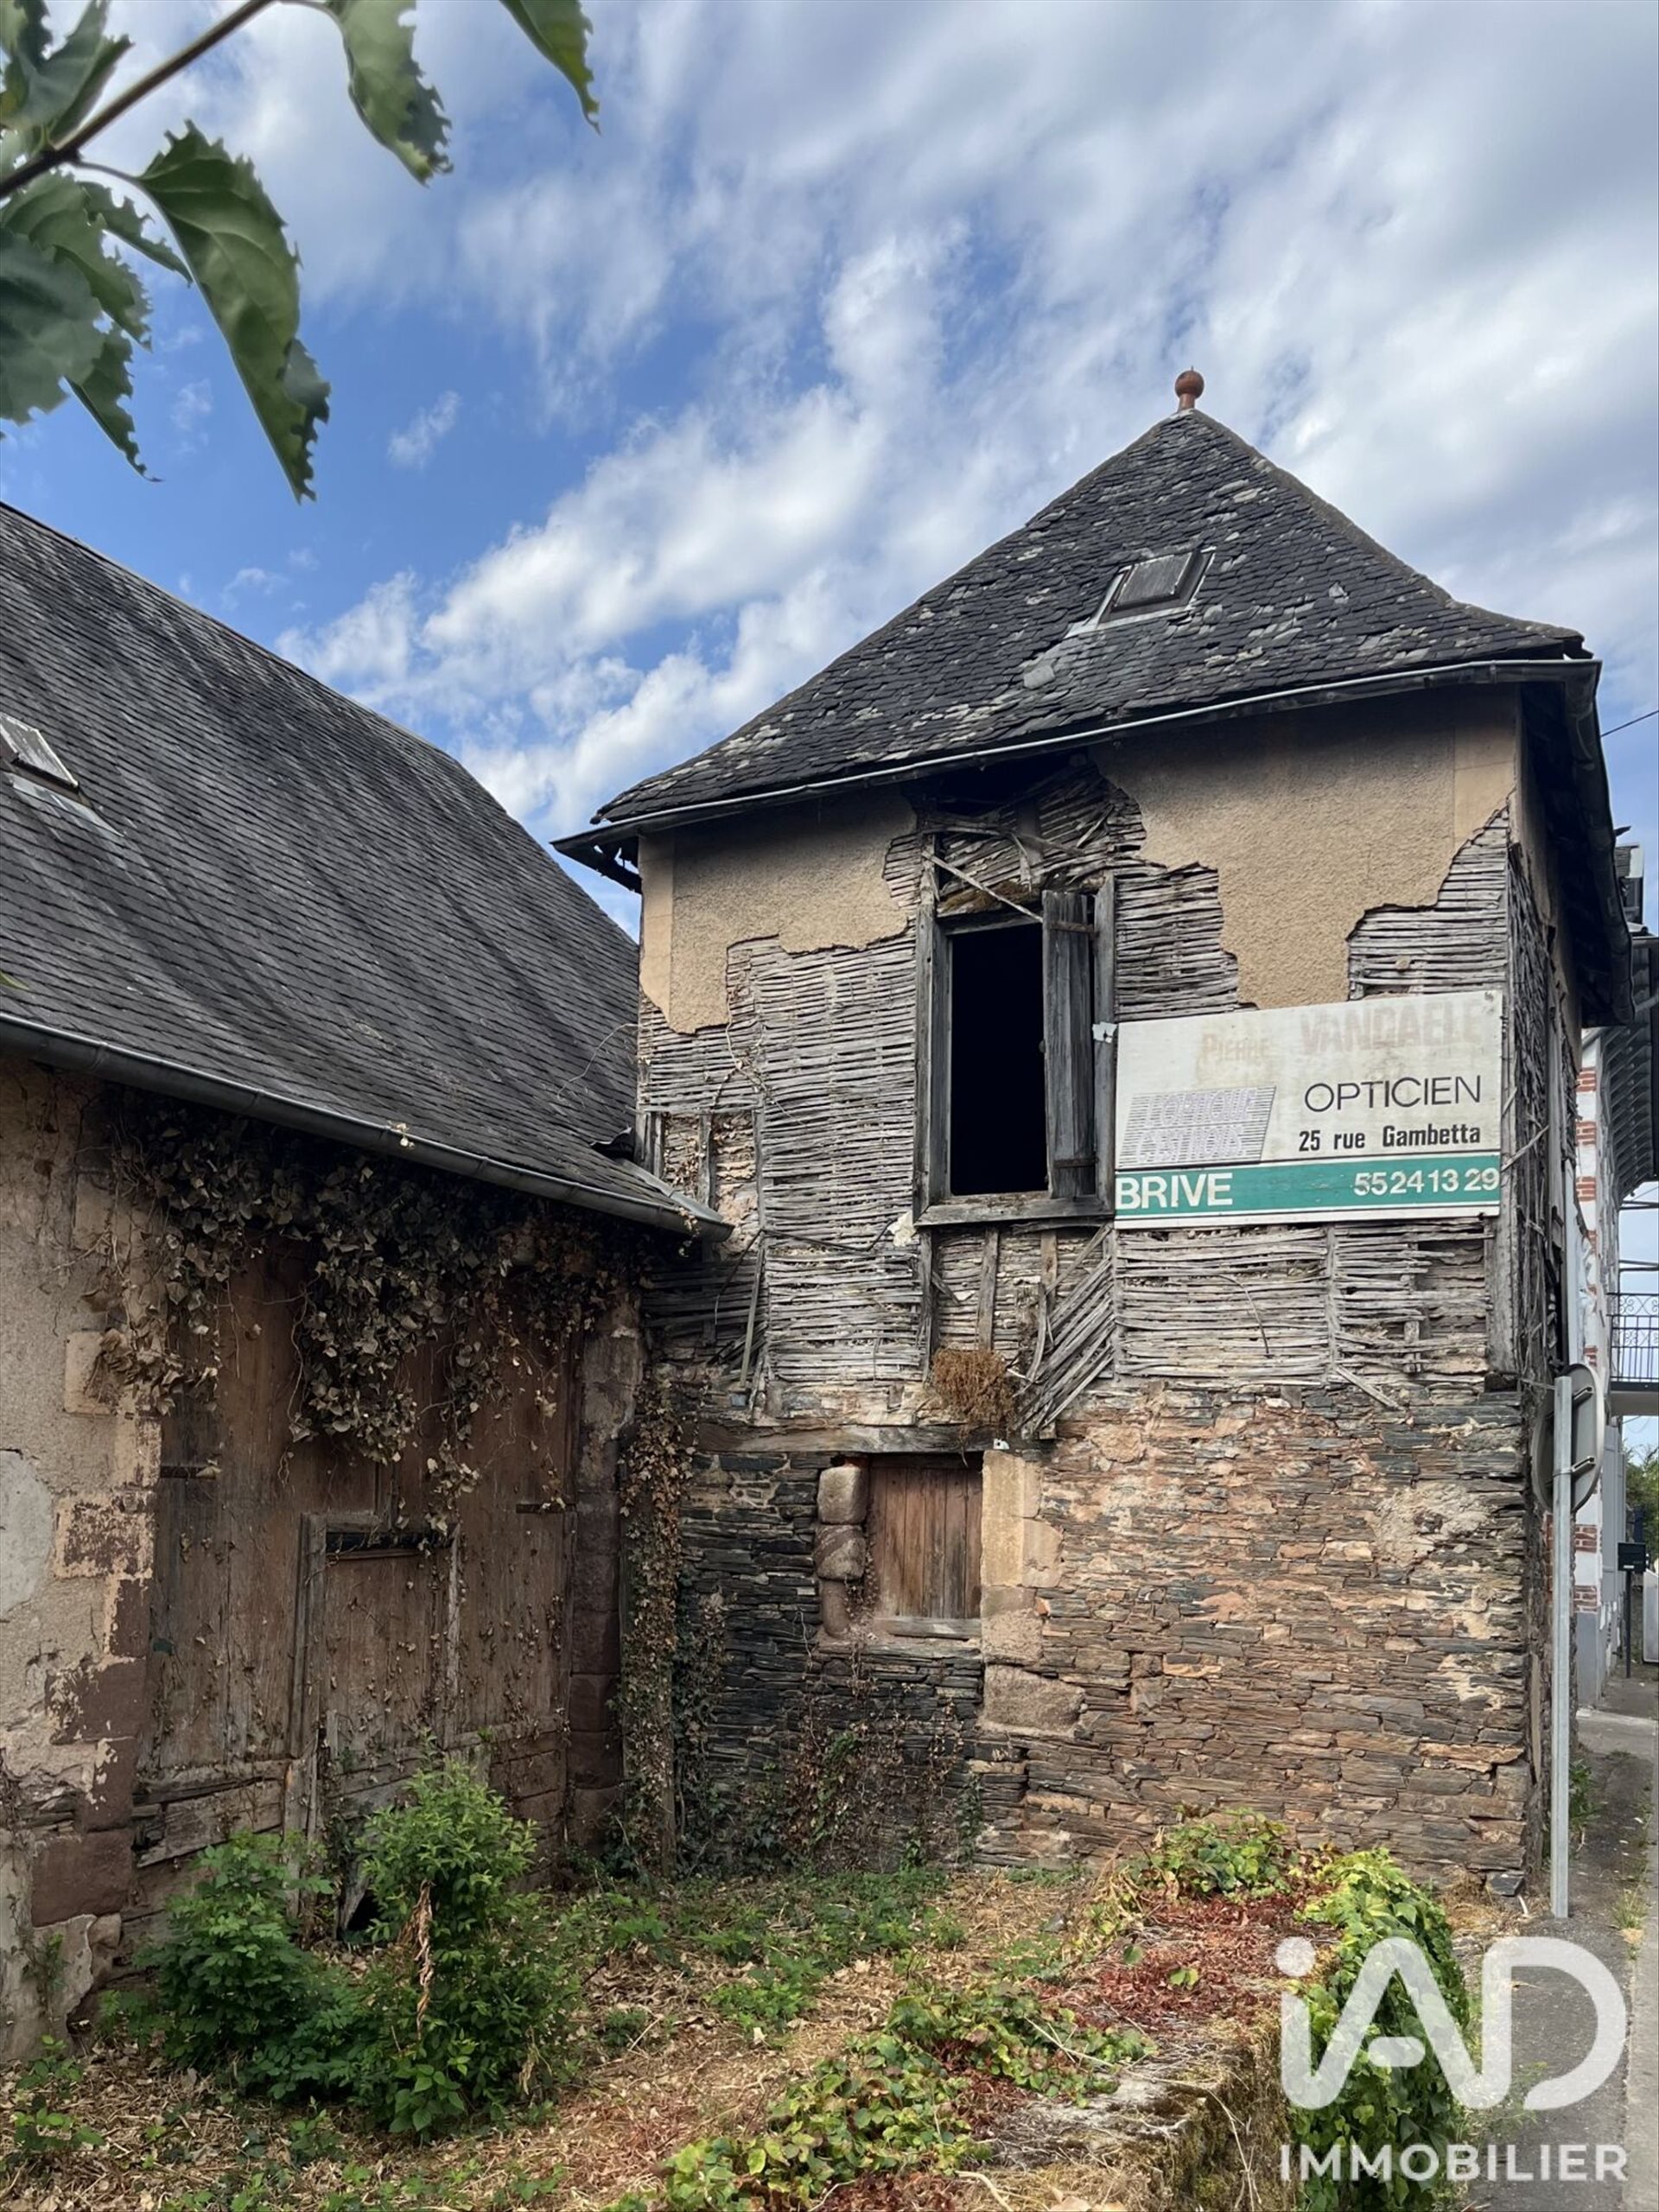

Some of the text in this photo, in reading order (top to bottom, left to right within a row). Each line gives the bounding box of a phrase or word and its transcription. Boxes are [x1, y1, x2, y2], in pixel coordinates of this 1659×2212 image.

[1304, 1075, 1481, 1112] OPTICIEN
[1299, 1124, 1481, 1152] 25 rue Gambetta
[1116, 1173, 1234, 1211] BRIVE
